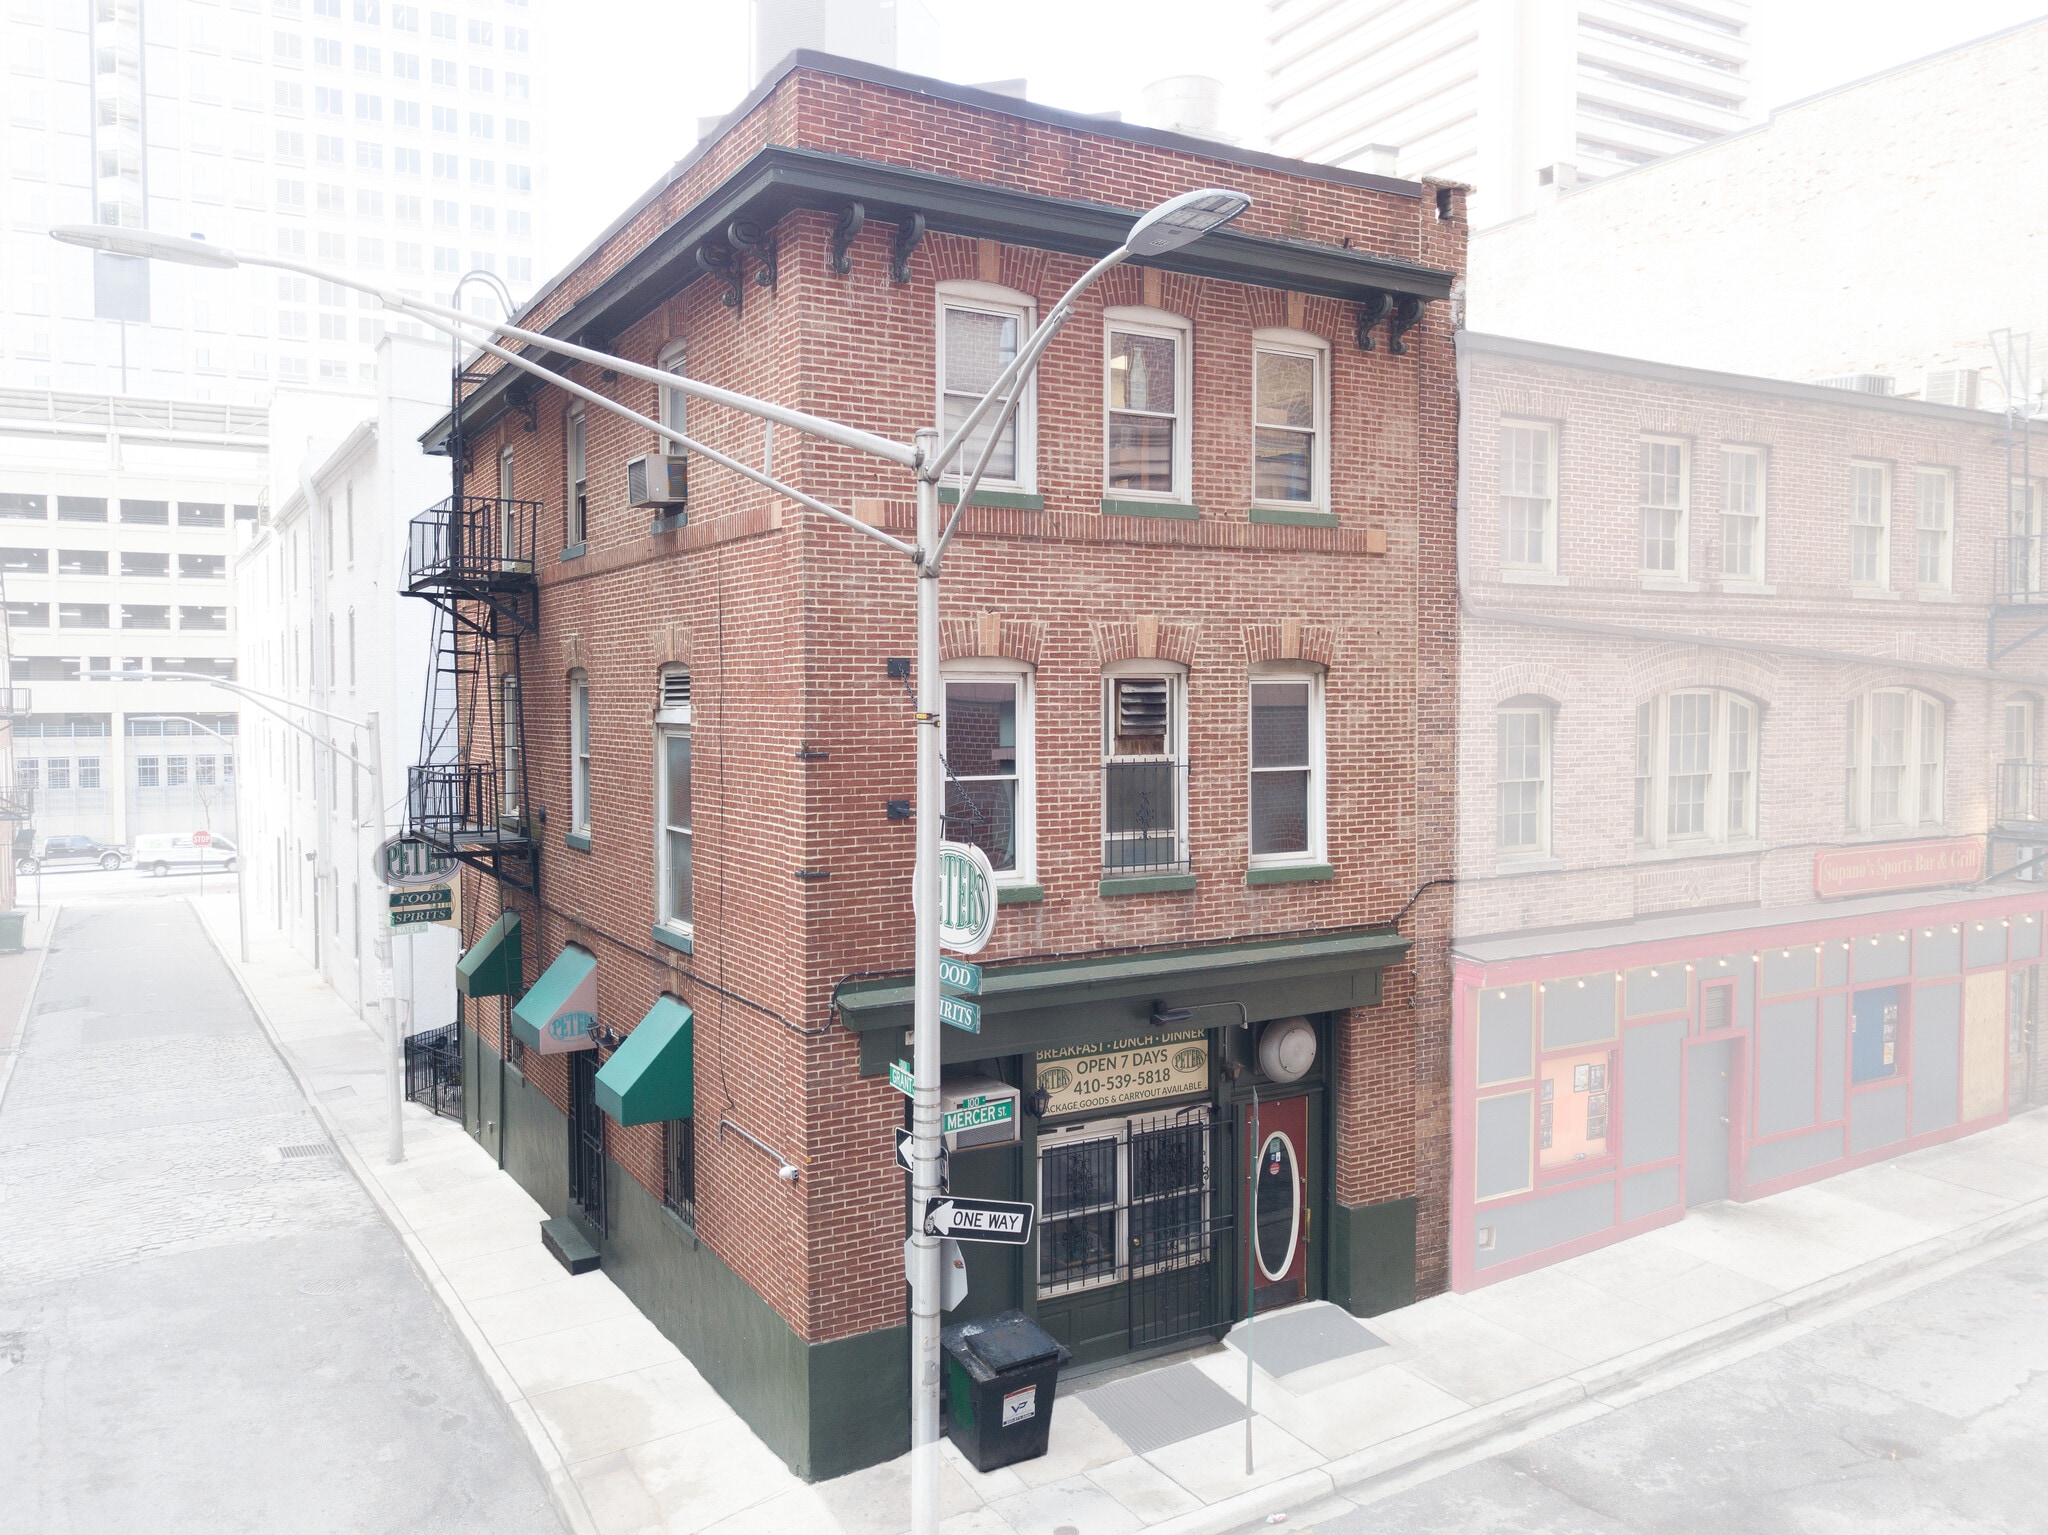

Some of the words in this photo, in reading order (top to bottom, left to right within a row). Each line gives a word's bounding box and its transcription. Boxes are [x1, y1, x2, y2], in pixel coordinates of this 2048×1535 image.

[193, 835, 211, 844] STOP
[1824, 858, 1874, 886] Supano's
[1877, 856, 1912, 880] Sports
[1915, 853, 1935, 872] Bar
[1938, 850, 1947, 870] &
[1951, 849, 1976, 867] Grill
[400, 892, 442, 905] FOOD
[395, 910, 446, 922] SPIRITS
[396, 923, 420, 934] WATER
[940, 962, 971, 986] OOD
[940, 1000, 972, 1026] IRITS
[1036, 1042, 1102, 1060] BREAKFAST
[1113, 1035, 1153, 1050] LUNCH
[1162, 1028, 1205, 1043] DINNER
[1077, 1056, 1117, 1074] OPEN
[1121, 1054, 1129, 1068] 7
[1133, 1049, 1168, 1067] DAYS
[892, 1069, 912, 1093] GRANT
[1074, 1068, 1171, 1095] 410-539-5818
[967, 1097, 980, 1108] 100
[1046, 1101, 1078, 1113] ACKAGE
[1080, 1096, 1109, 1108] GOODS
[1111, 1094, 1117, 1104] &
[1119, 1088, 1161, 1102] CARRYOUT
[1162, 1081, 1202, 1096] AVAILABLE
[947, 1106, 996, 1130] MERCER
[953, 1211, 983, 1227] ONE
[989, 1214, 1019, 1230] WAY
